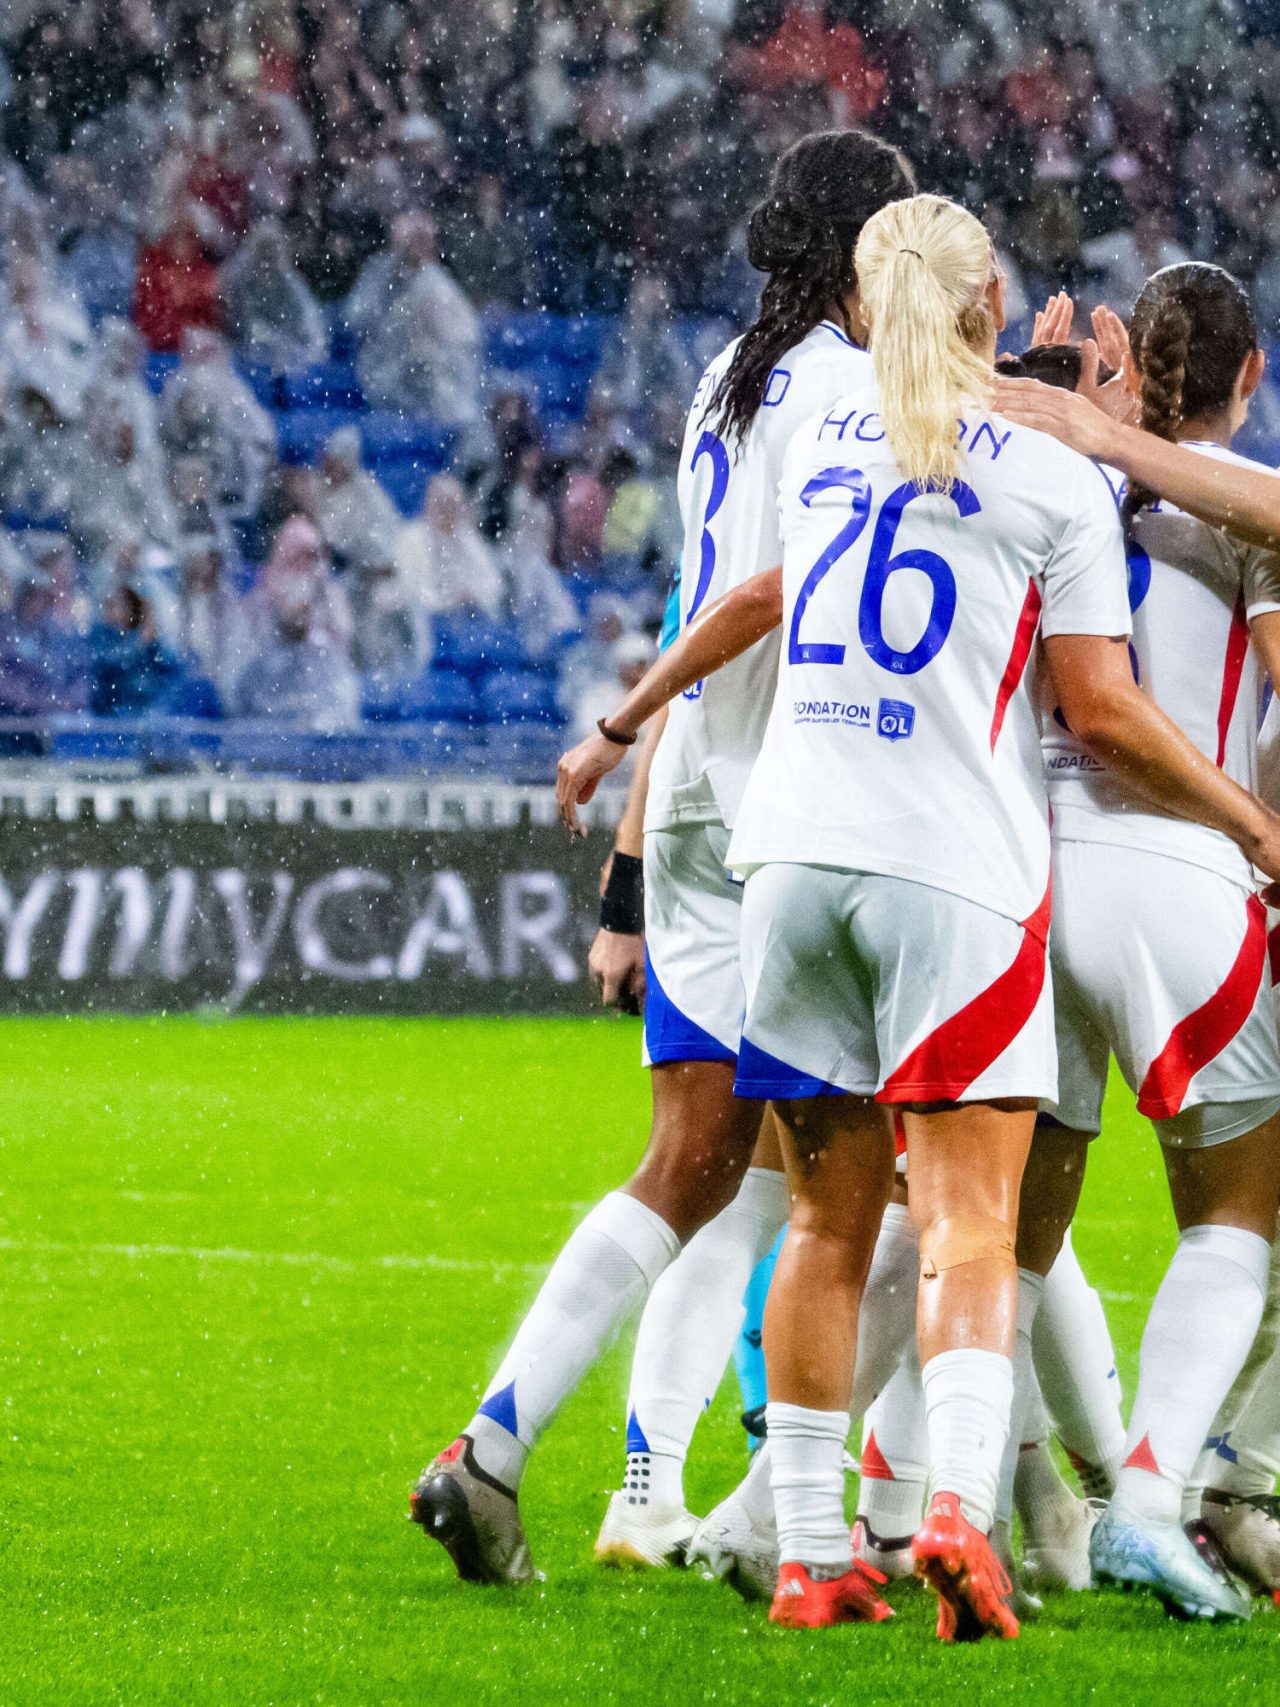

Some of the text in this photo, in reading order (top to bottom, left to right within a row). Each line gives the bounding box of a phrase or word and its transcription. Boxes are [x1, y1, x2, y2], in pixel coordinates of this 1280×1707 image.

[818, 410, 1011, 461] HON
[788, 466, 982, 676] 26
[881, 715, 908, 735] OL
